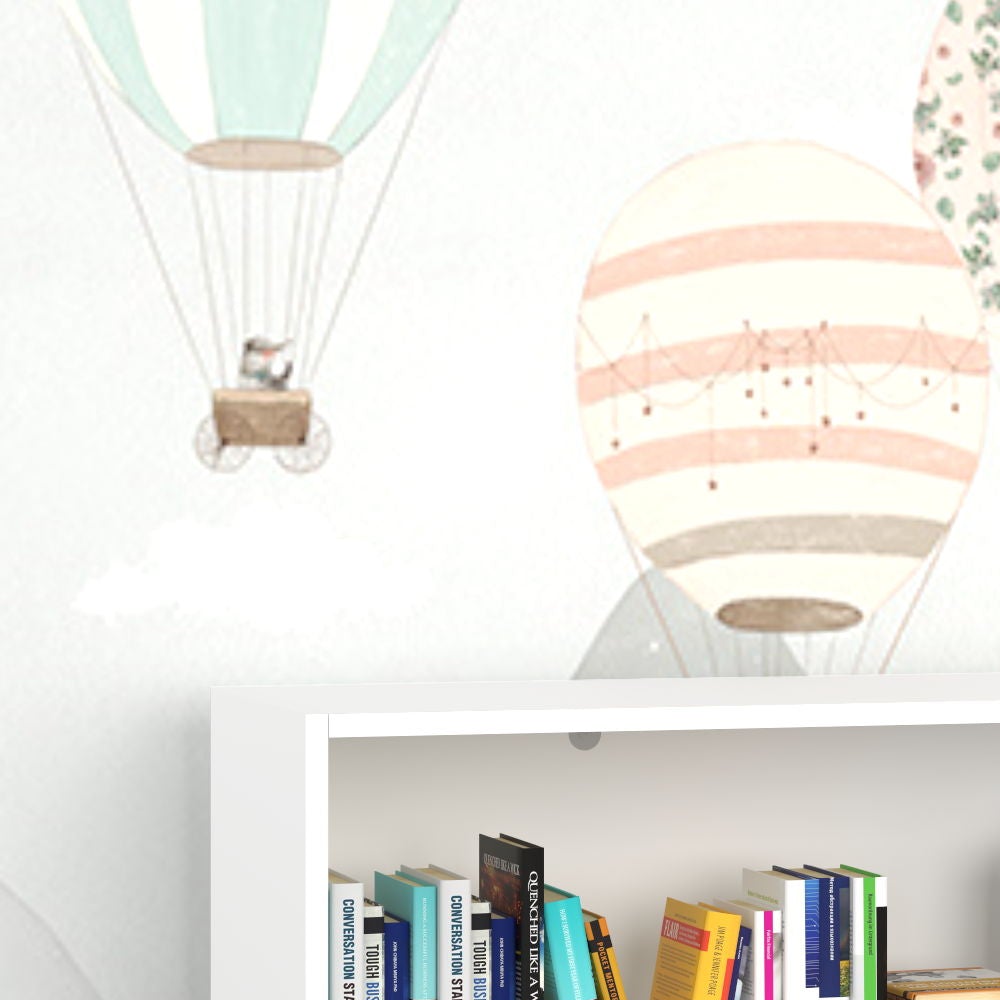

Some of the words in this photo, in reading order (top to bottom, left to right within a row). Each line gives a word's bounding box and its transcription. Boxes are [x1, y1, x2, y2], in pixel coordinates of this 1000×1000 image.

[528, 871, 539, 944] QUENCHED
[342, 899, 355, 980] CONVERSATION
[450, 895, 463, 976] CONVERSATION
[365, 944, 380, 979] TOUGH
[473, 940, 487, 975] TOUGH
[529, 947, 539, 974] LIKE
[596, 941, 609, 971] POCKET
[529, 976, 539, 987] A
